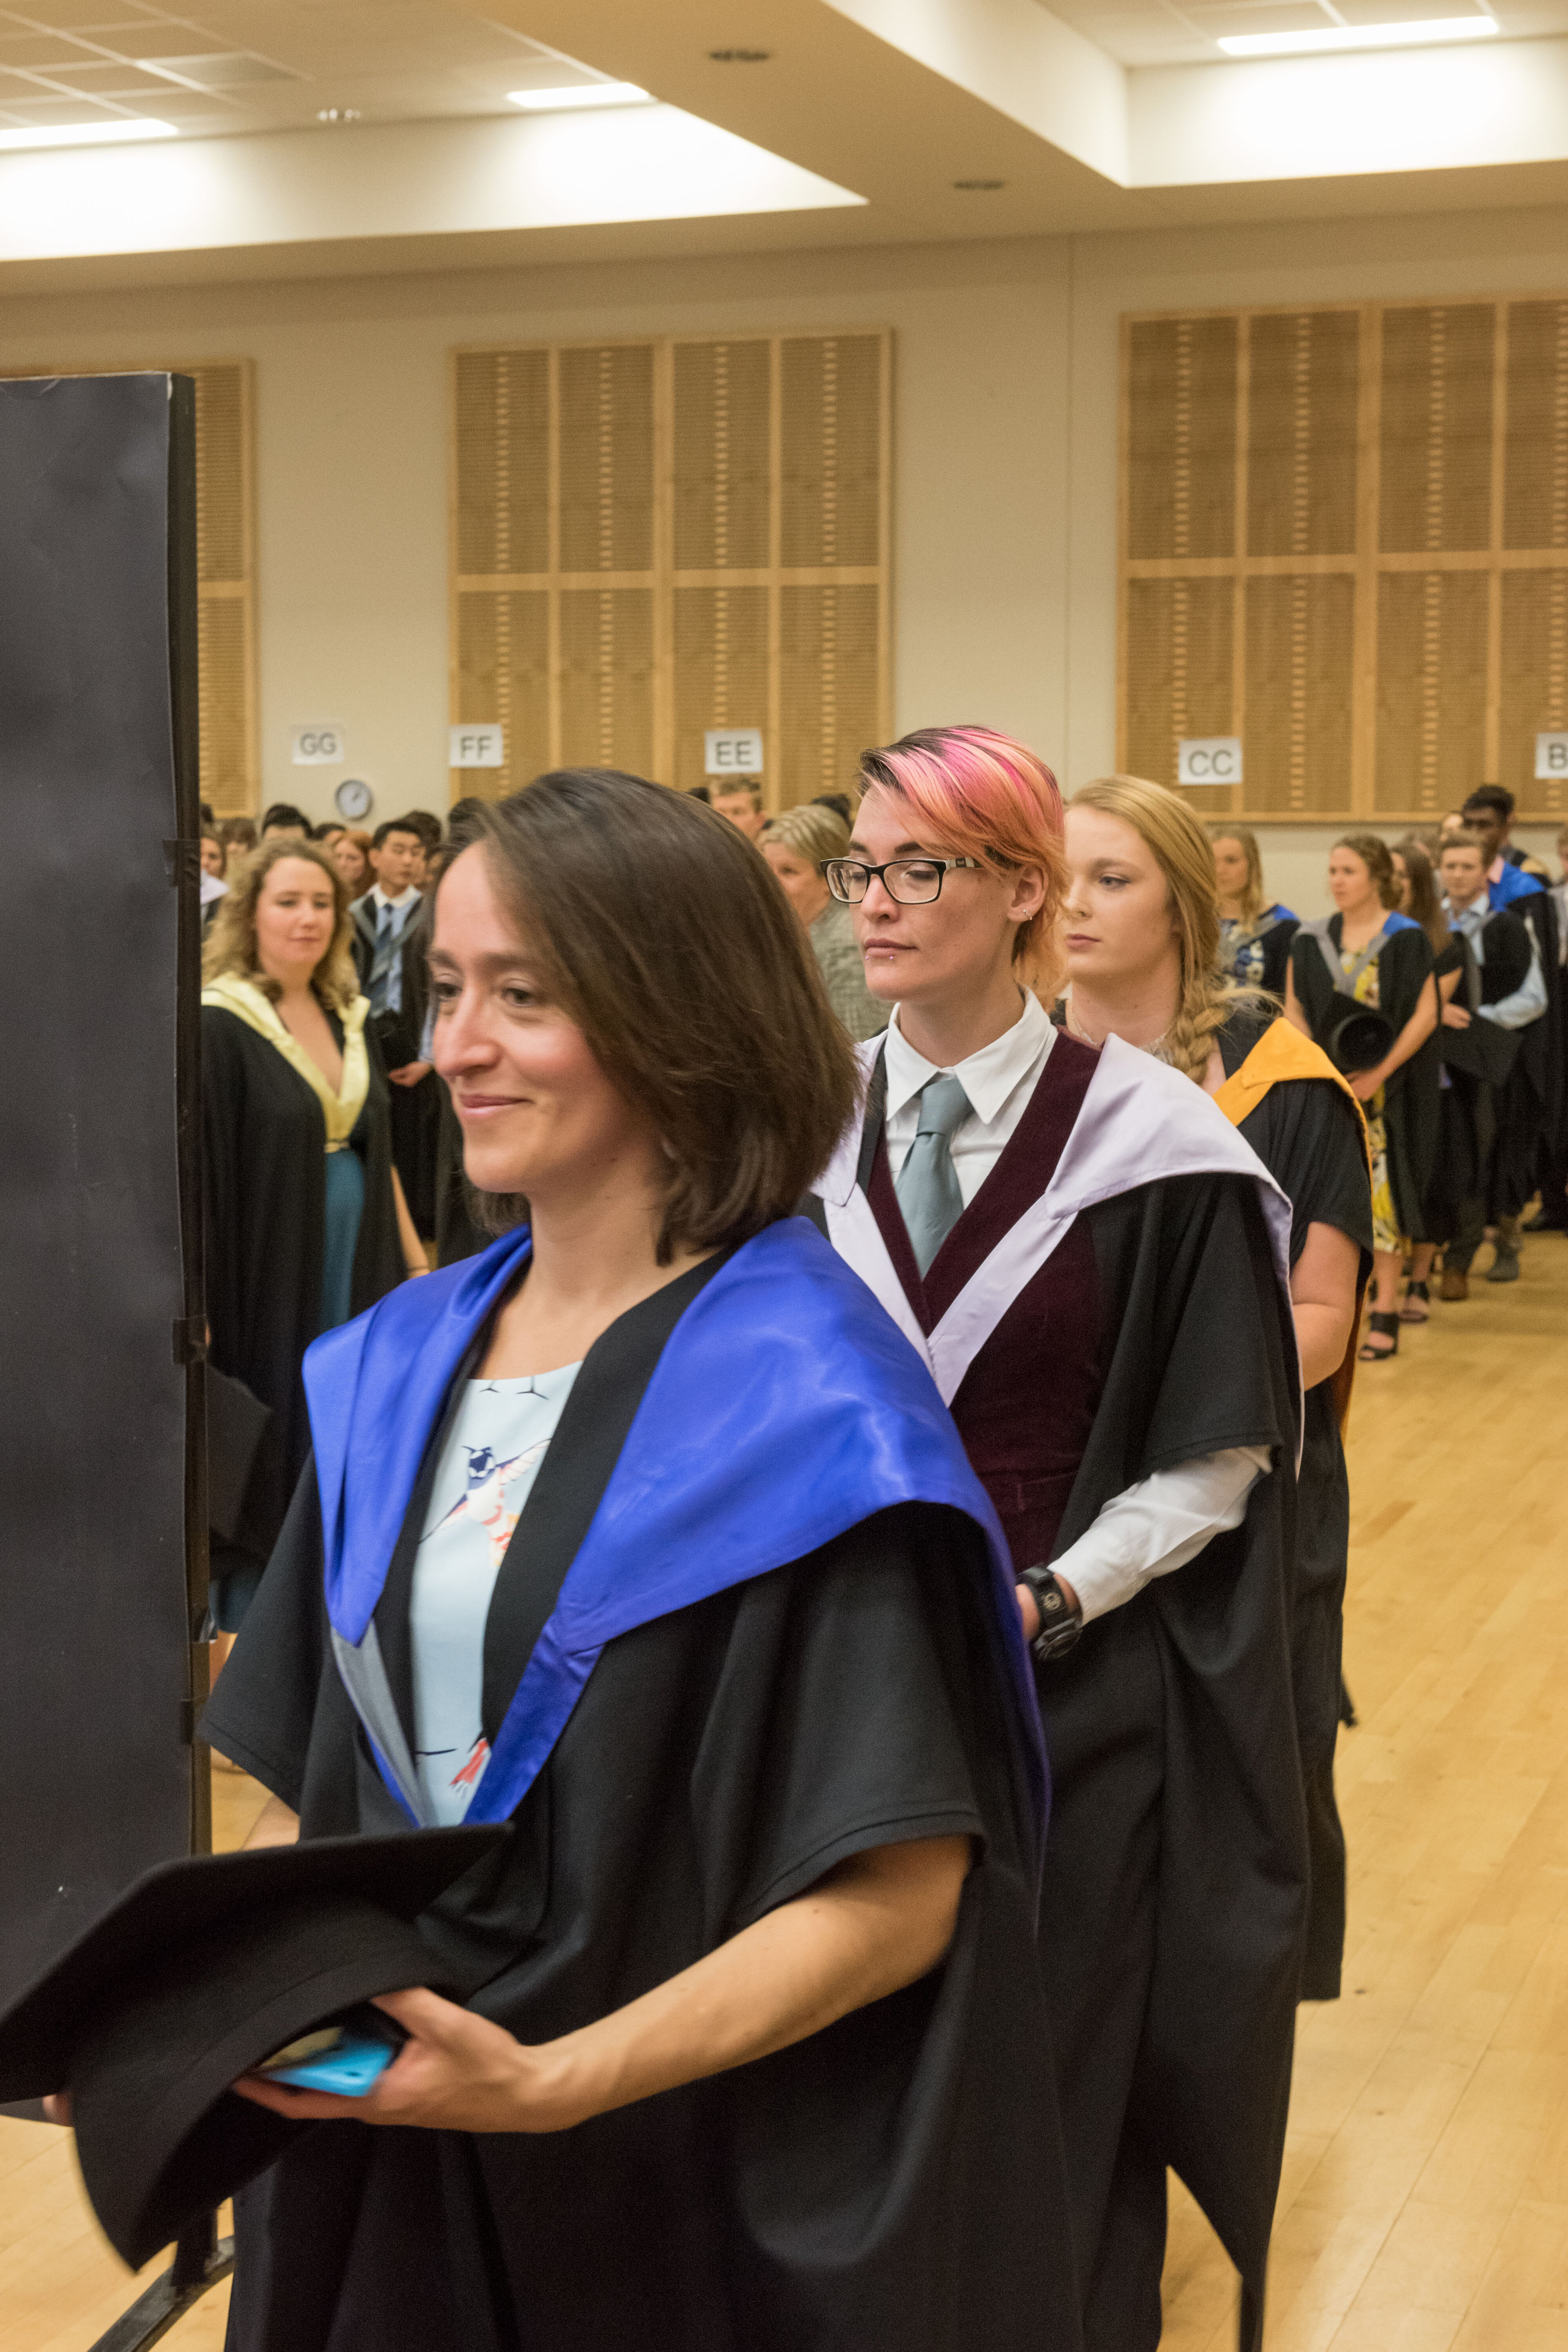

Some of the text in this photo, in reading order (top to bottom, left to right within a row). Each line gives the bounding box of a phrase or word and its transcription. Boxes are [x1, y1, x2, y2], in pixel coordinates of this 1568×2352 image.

[299, 732, 336, 755] GG
[460, 736, 492, 759] FF
[715, 740, 752, 766] EE
[1548, 742, 1567, 769] B
[1188, 750, 1232, 776] CC
